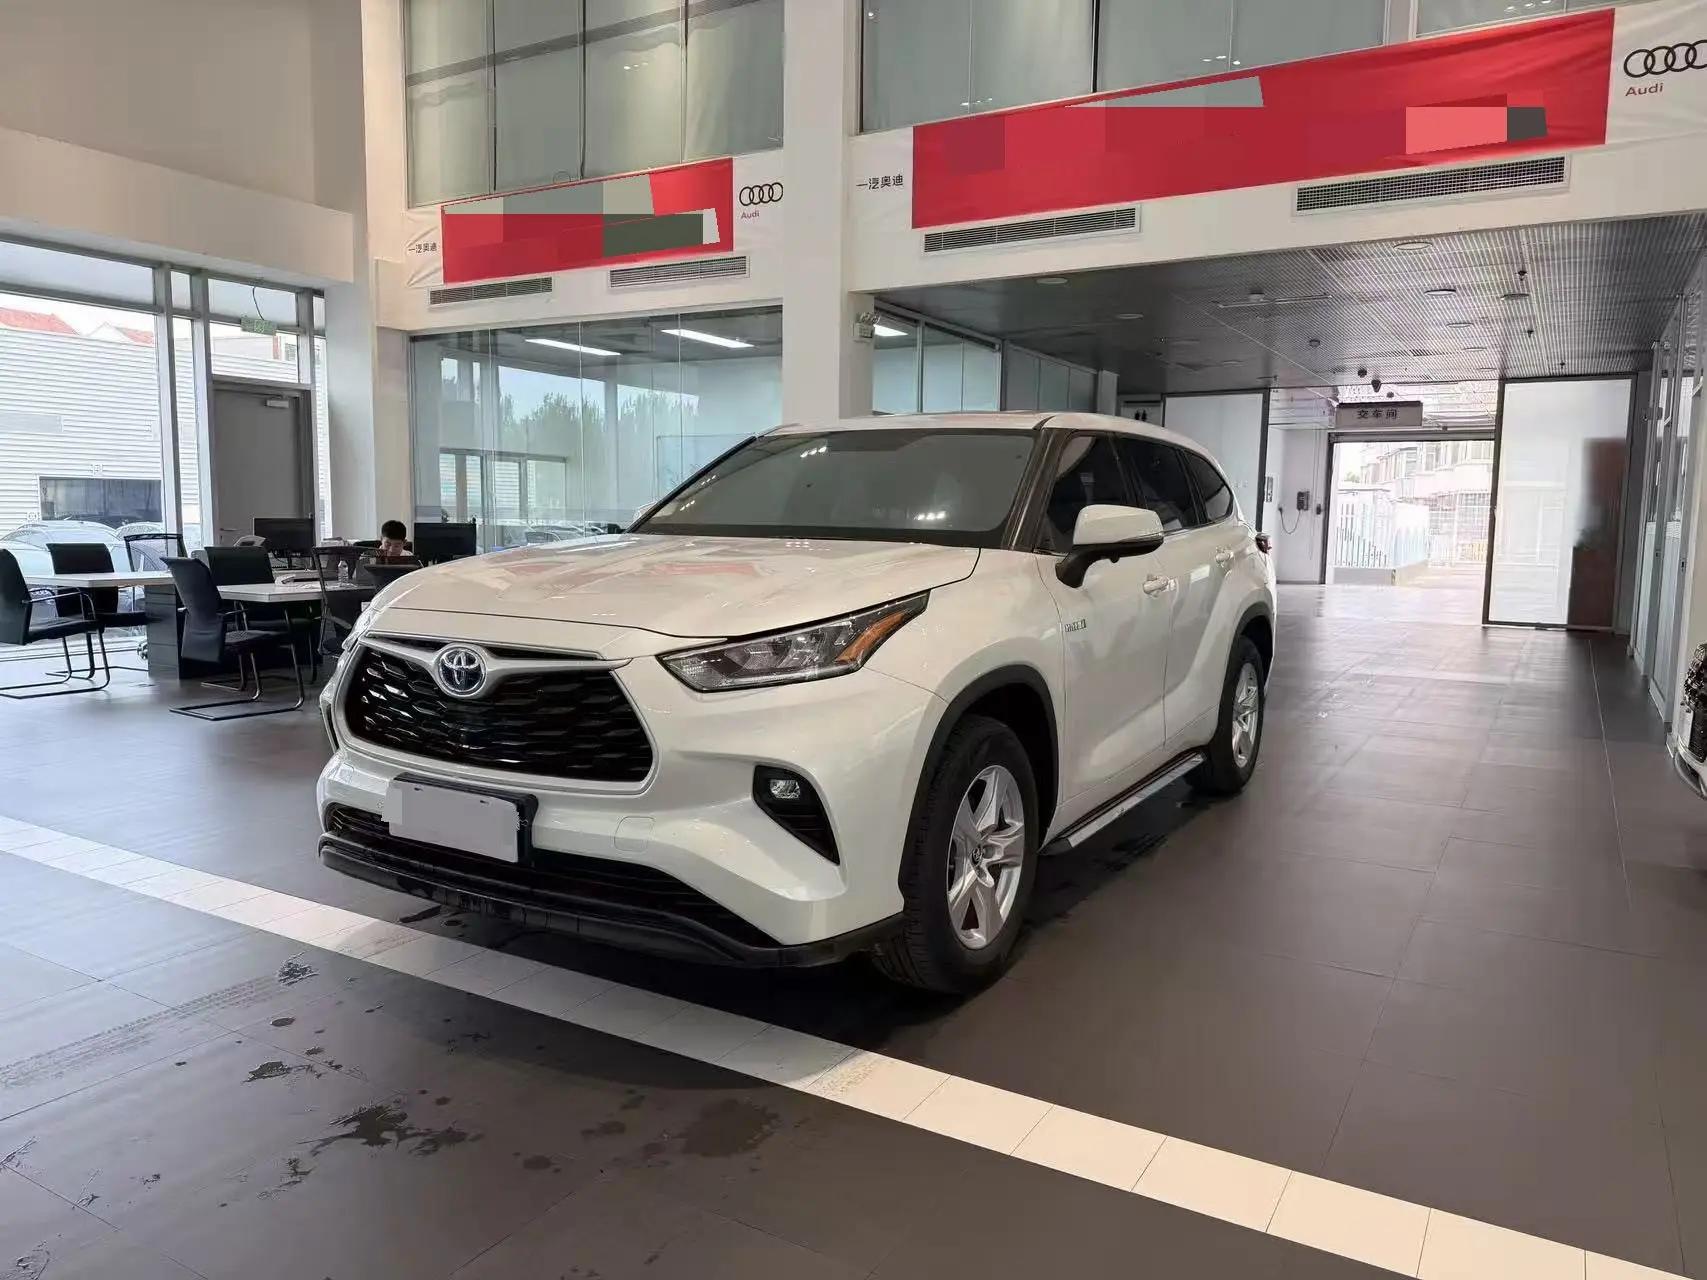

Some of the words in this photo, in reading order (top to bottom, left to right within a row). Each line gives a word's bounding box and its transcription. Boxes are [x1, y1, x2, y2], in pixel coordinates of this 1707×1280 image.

[1625, 82, 1664, 97] Audi
[855, 173, 904, 190] 一汽奥迪
[740, 210, 760, 219] Audi
[1357, 408, 1397, 420] 交车间
